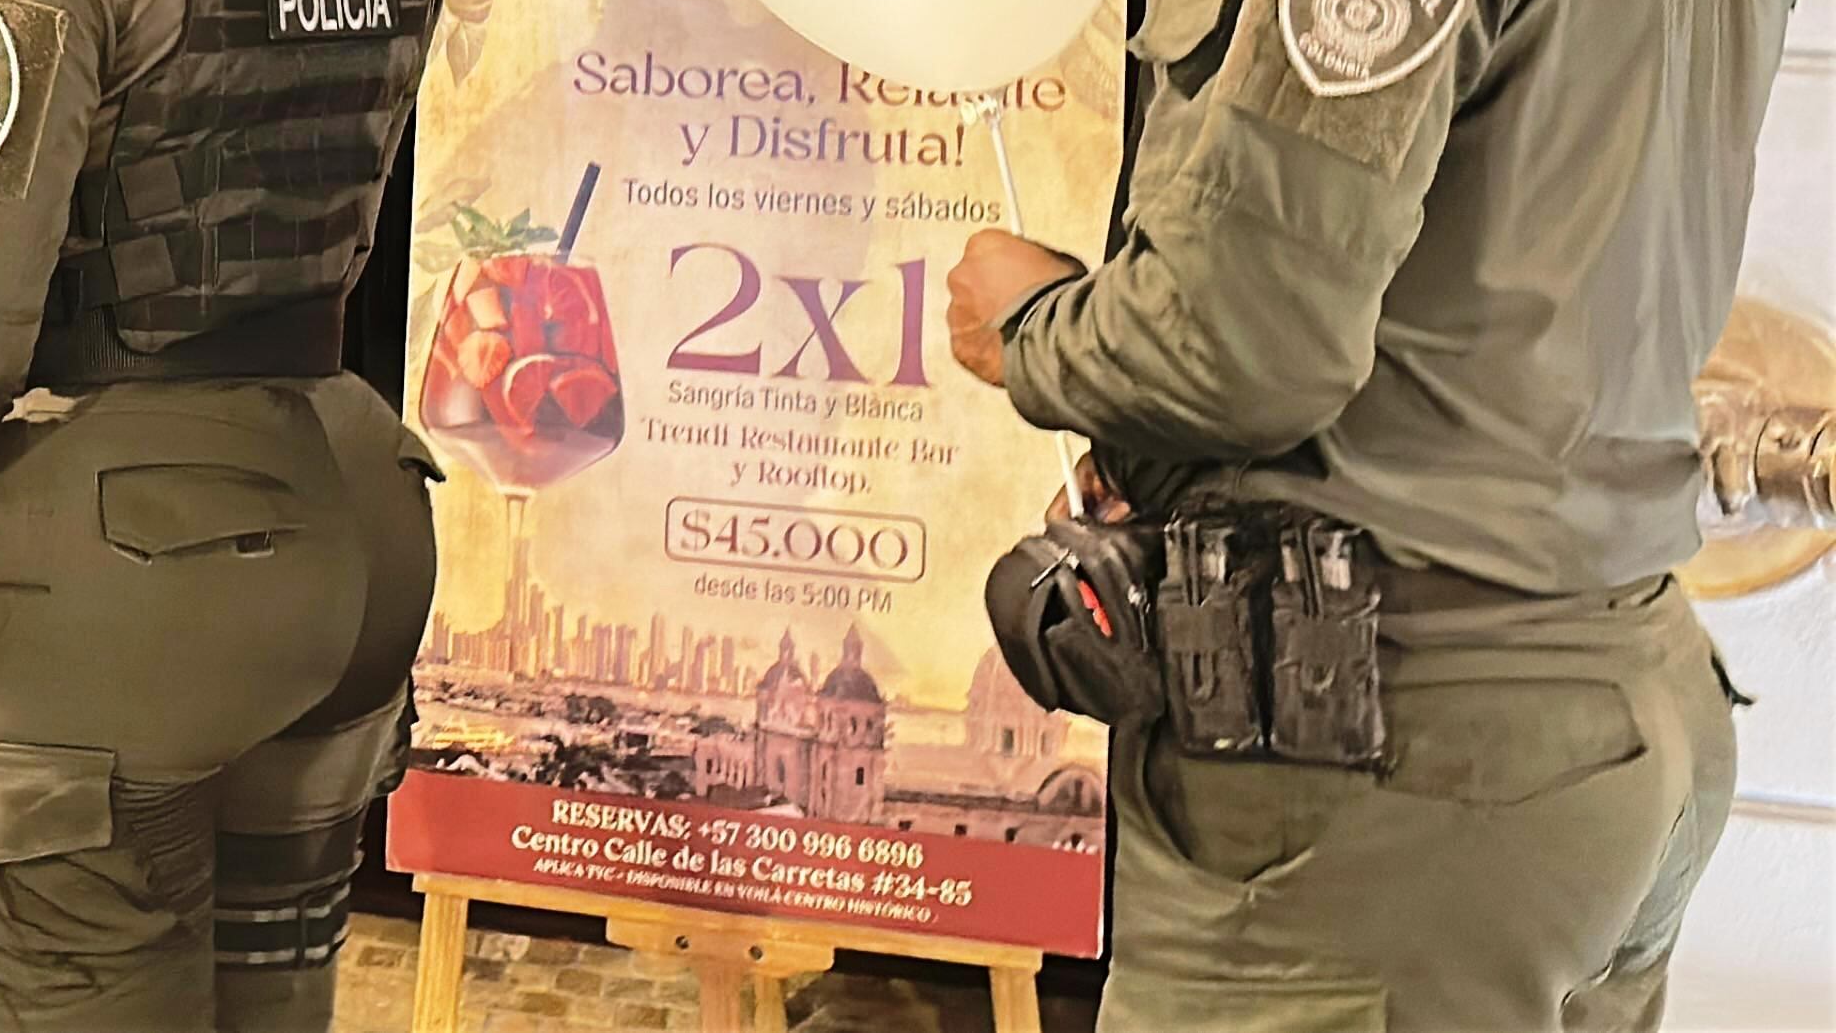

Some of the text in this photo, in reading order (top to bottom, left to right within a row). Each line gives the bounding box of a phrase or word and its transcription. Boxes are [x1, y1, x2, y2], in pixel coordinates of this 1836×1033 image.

[573, 50, 816, 105] Saborea,
[680, 114, 965, 167] y Disfruta!
[623, 177, 1001, 223] Todos los viernes y sábados
[666, 242, 932, 388] 2x1
[667, 379, 924, 422] Sangría Tinta y Blanca
[740, 423, 900, 460] Restaurante
[910, 438, 960, 466] Bar
[730, 461, 747, 487] y
[680, 509, 909, 570] $45.000
[694, 572, 893, 614] desde las 5:00 PM
[552, 799, 924, 869] RESERVAS: +57 300 996 6896
[511, 825, 973, 907] Centro Calle de las Carretas #34-85
